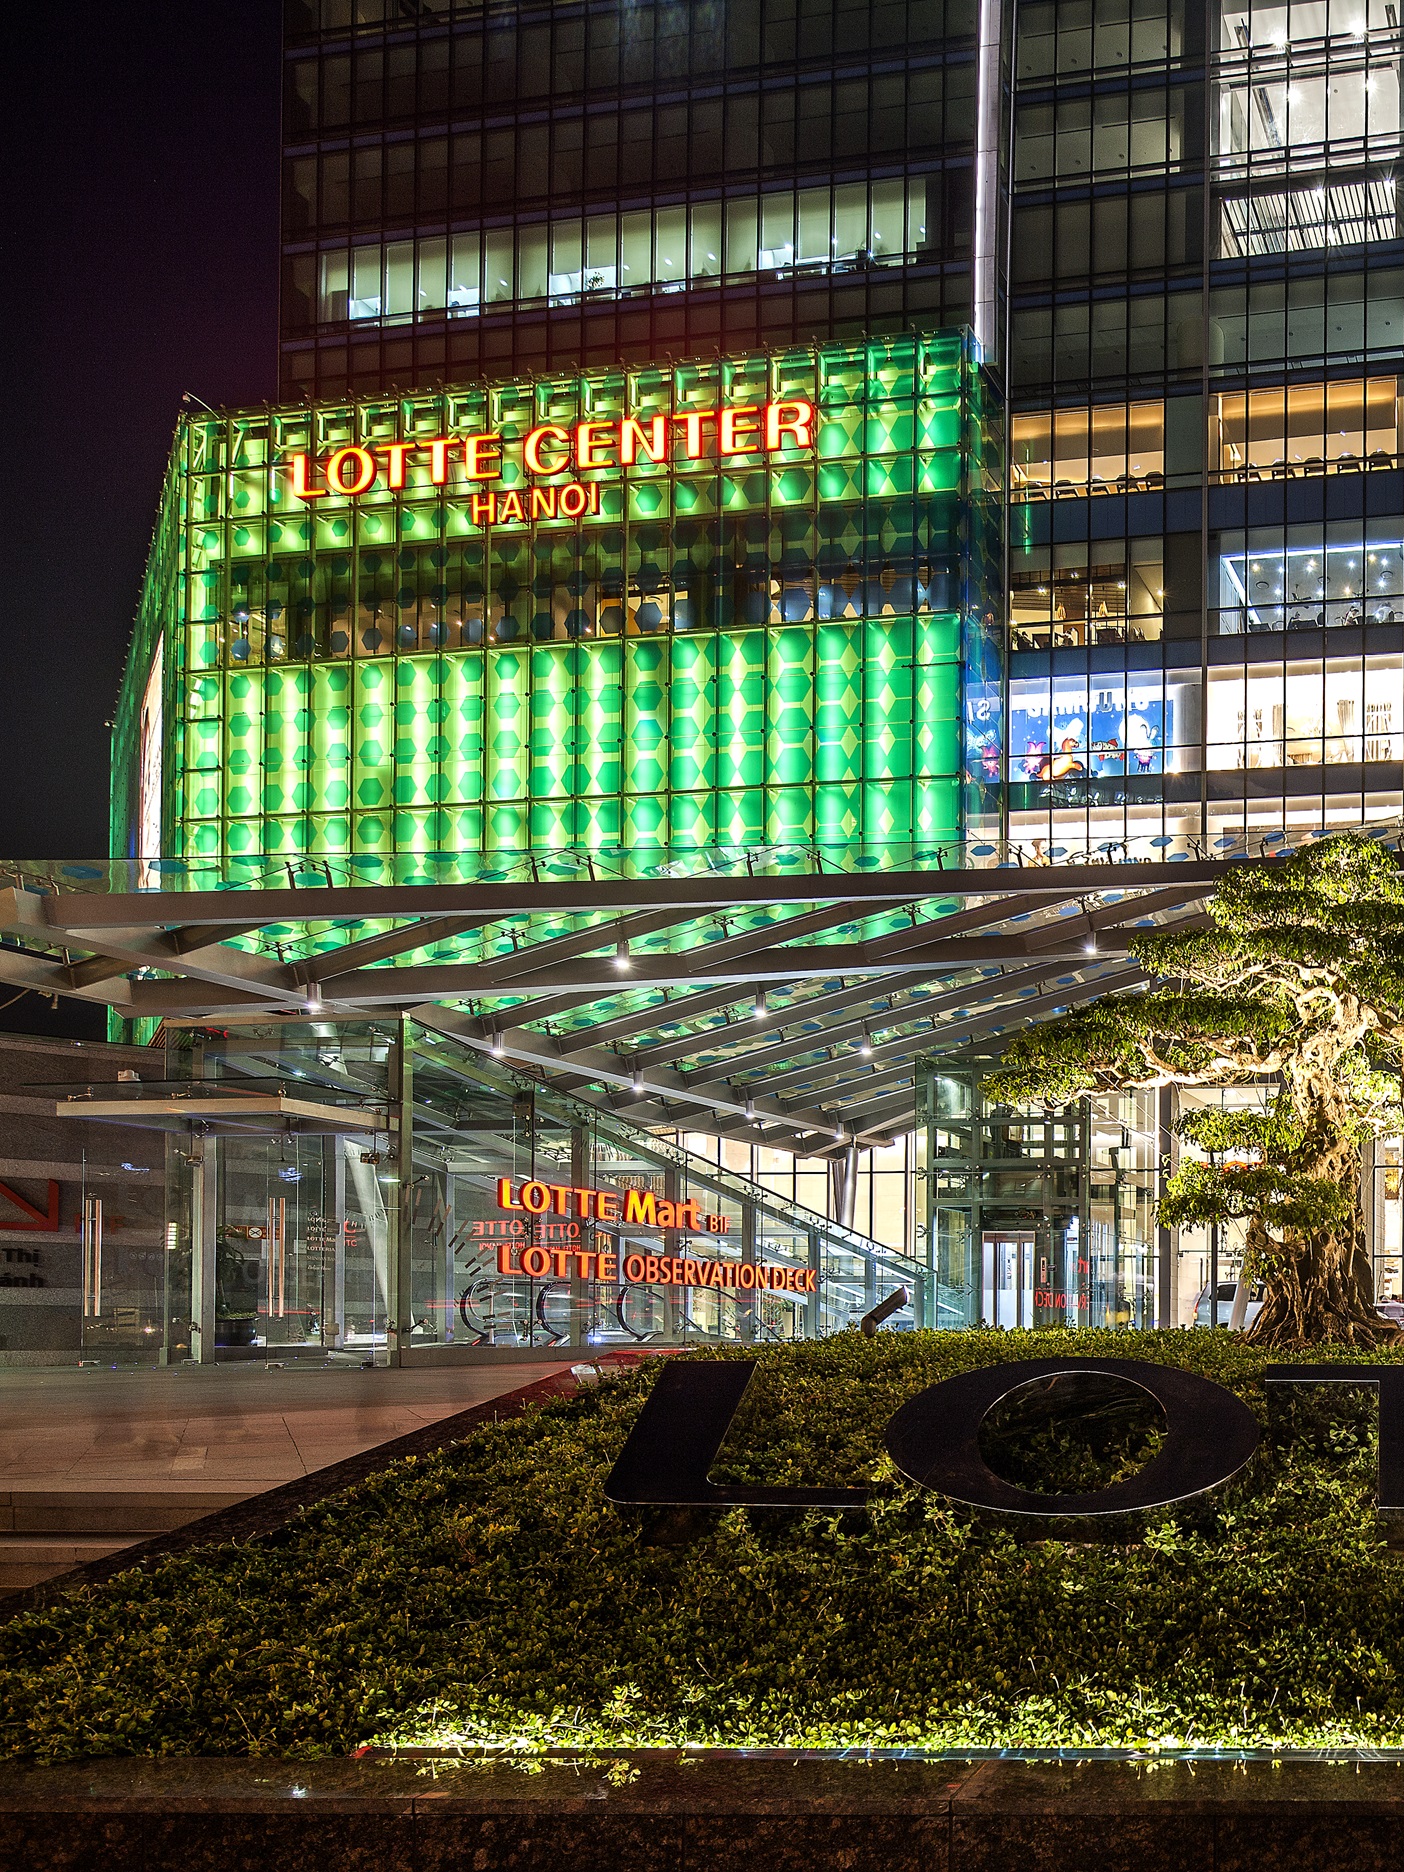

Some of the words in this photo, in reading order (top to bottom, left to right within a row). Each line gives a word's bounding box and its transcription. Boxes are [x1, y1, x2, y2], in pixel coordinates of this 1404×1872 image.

[291, 433, 504, 499] LOTTE
[523, 400, 814, 477] CENTER
[471, 482, 601, 526] HANOI
[497, 1178, 618, 1221] LOTTE
[623, 1187, 702, 1231] Mart
[706, 1214, 732, 1235] B1F
[497, 1245, 617, 1281] LOTTE
[623, 1254, 769, 1291] OBSERVATION
[771, 1267, 817, 1292] DECK
